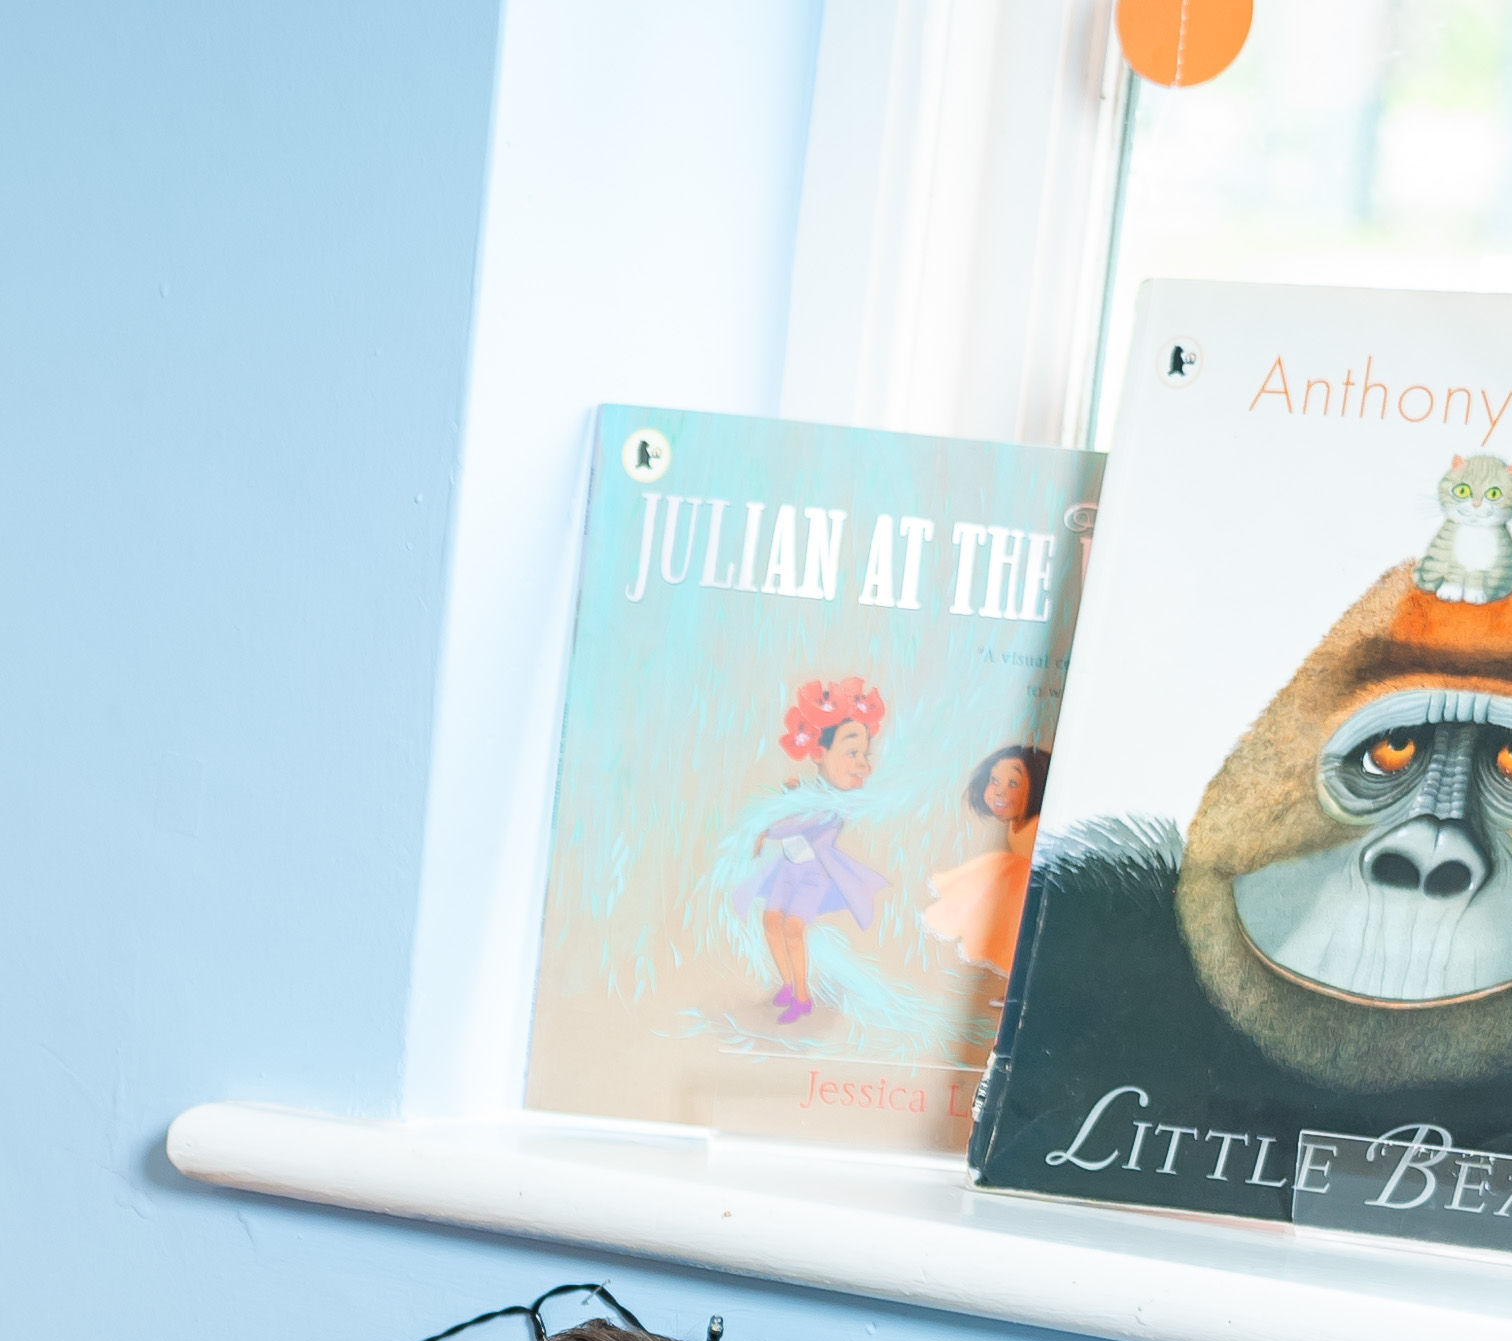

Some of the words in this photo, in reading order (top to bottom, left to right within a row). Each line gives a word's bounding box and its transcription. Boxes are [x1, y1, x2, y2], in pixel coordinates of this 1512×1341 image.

[625, 492, 848, 603] JULIAN
[858, 513, 935, 611] AT
[948, 522, 1055, 623] THE
[1001, 651, 1049, 669] visual
[799, 1069, 927, 1116] Jessica
[1045, 1085, 1340, 1195] LITTLE
